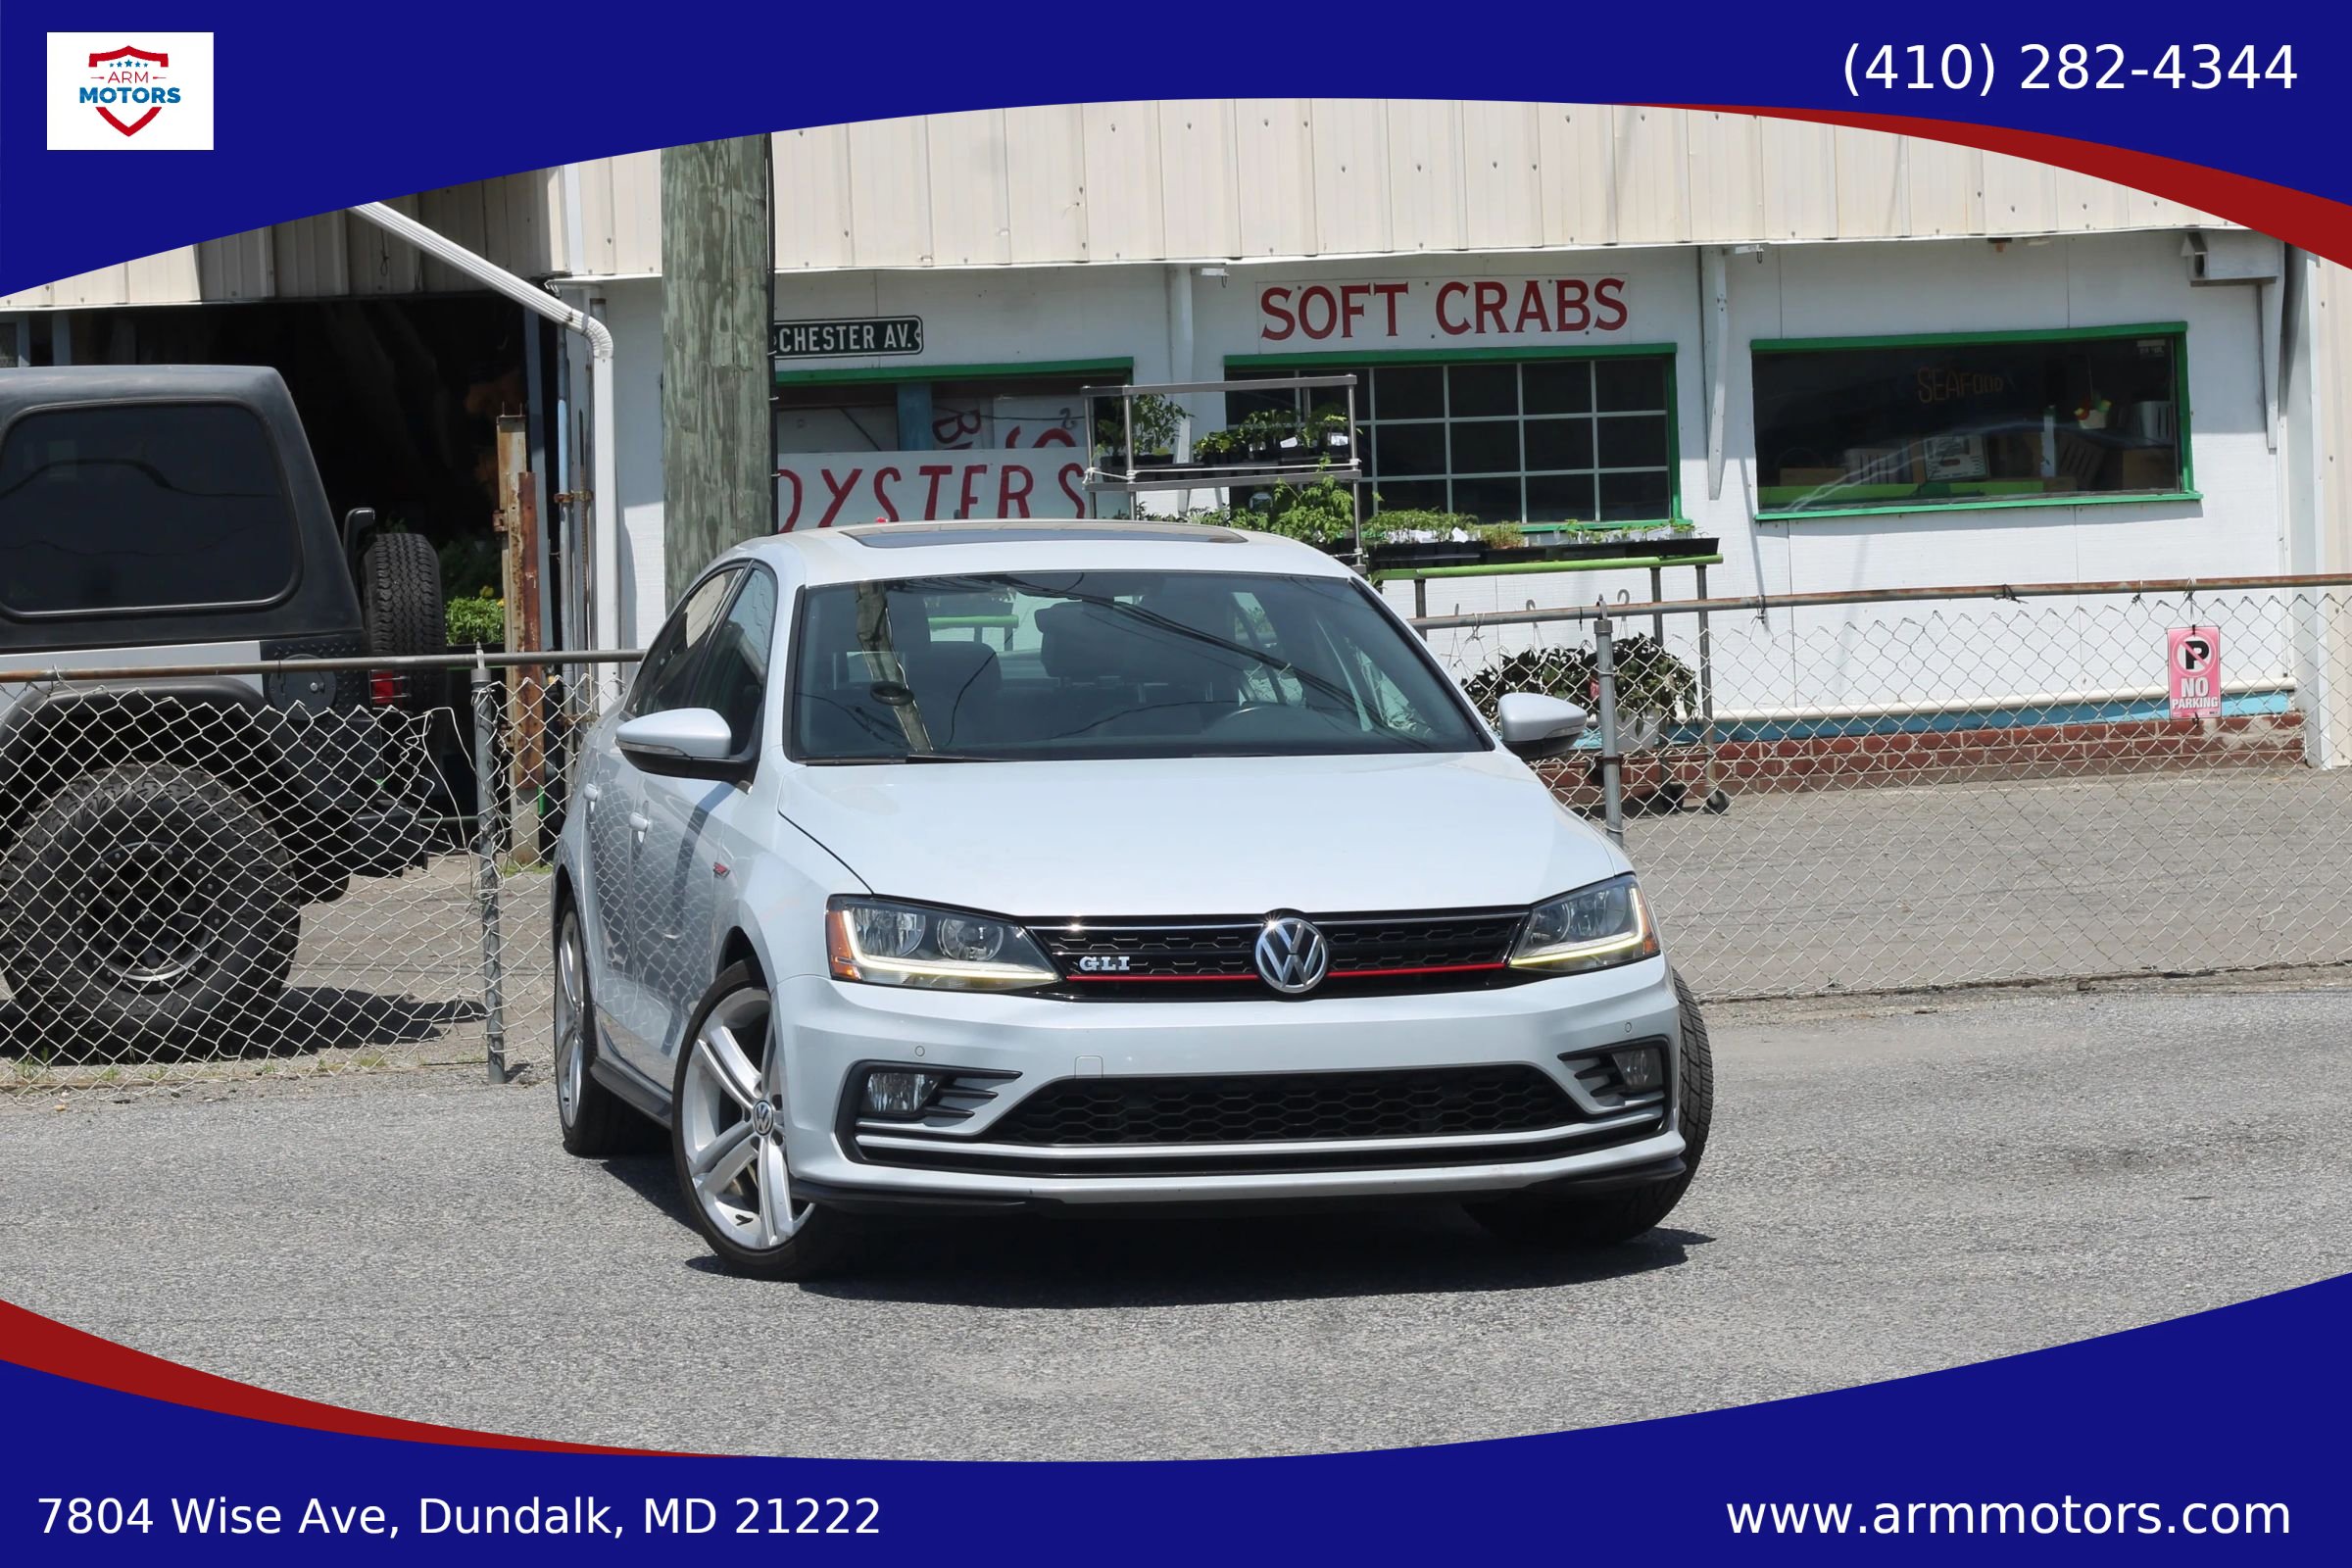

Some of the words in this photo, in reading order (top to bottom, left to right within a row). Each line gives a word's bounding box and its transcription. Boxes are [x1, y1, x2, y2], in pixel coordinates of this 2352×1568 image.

[1260, 280, 1409, 341] SOFT
[1436, 277, 1628, 335] CRABS
[884, 323, 912, 348] AV.
[1917, 366, 2004, 404] SEAFOOD
[2180, 677, 2209, 698] NO
[2171, 697, 2220, 710] PARKING
[1079, 956, 1130, 971] GLI
